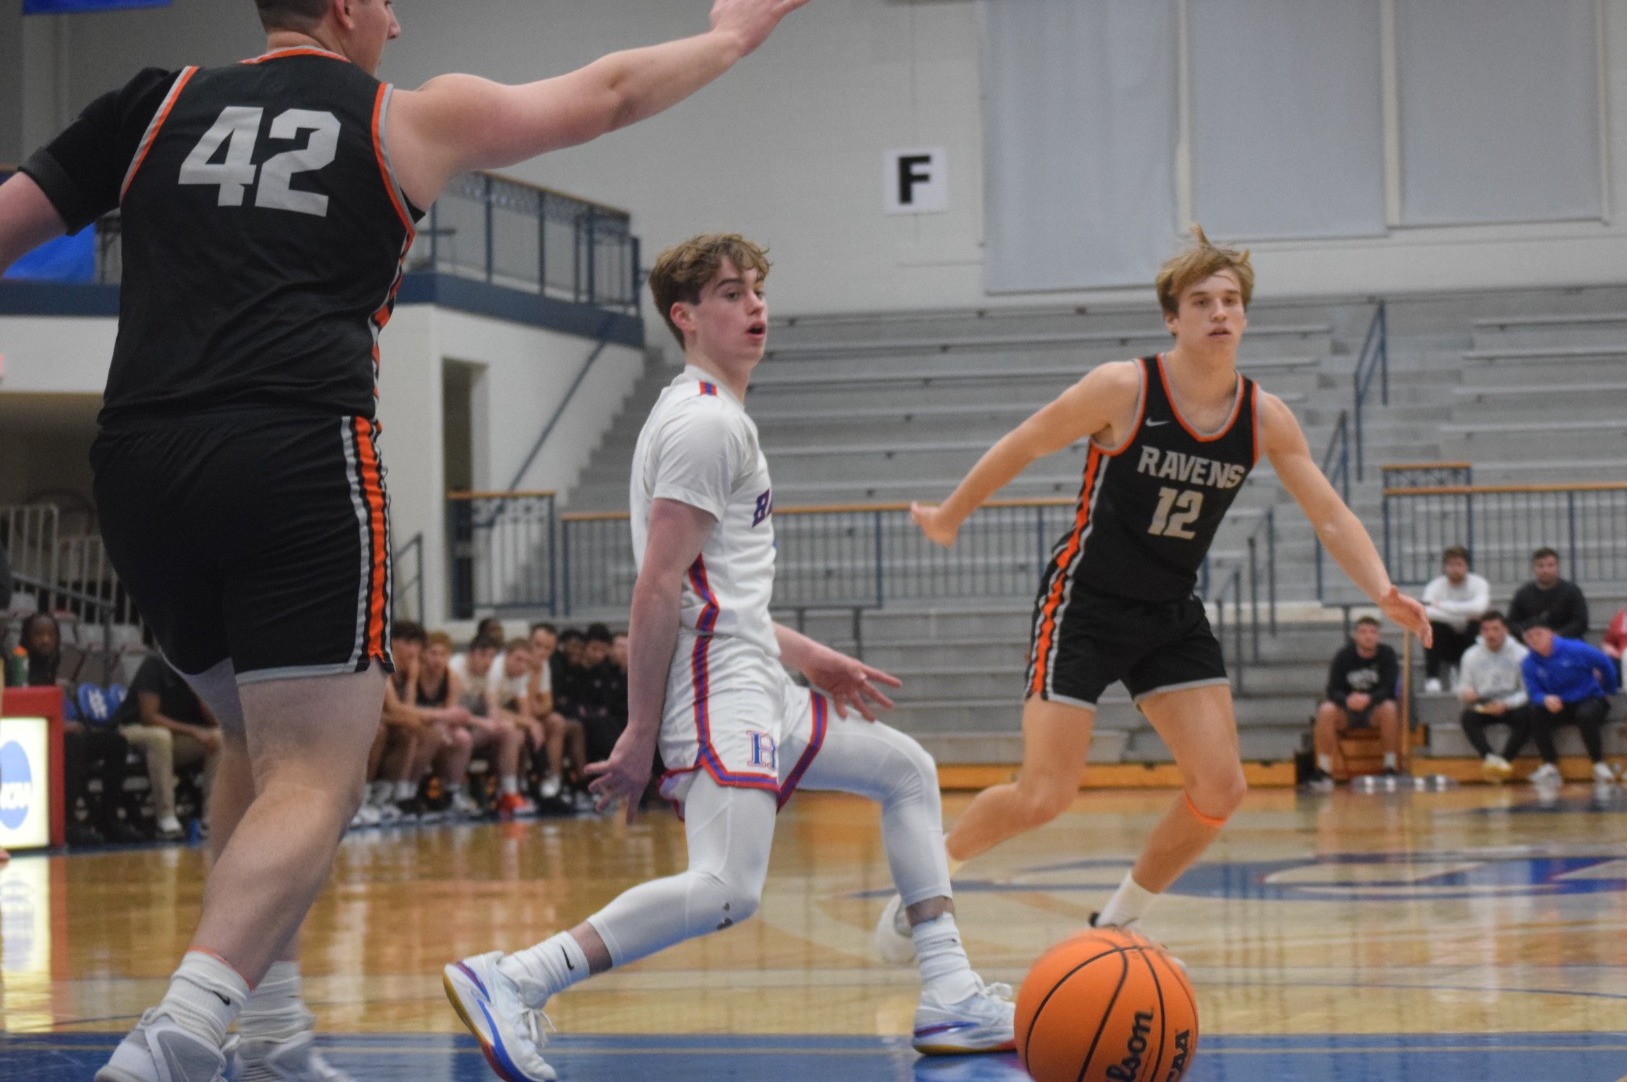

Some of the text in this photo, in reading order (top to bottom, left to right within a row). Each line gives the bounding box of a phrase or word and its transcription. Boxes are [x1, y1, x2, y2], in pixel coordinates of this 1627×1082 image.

[178, 105, 341, 217] 42
[898, 155, 931, 204] F
[1137, 445, 1245, 489] RAVENS
[1147, 486, 1204, 540] 12
[1105, 1010, 1153, 1082] lson
